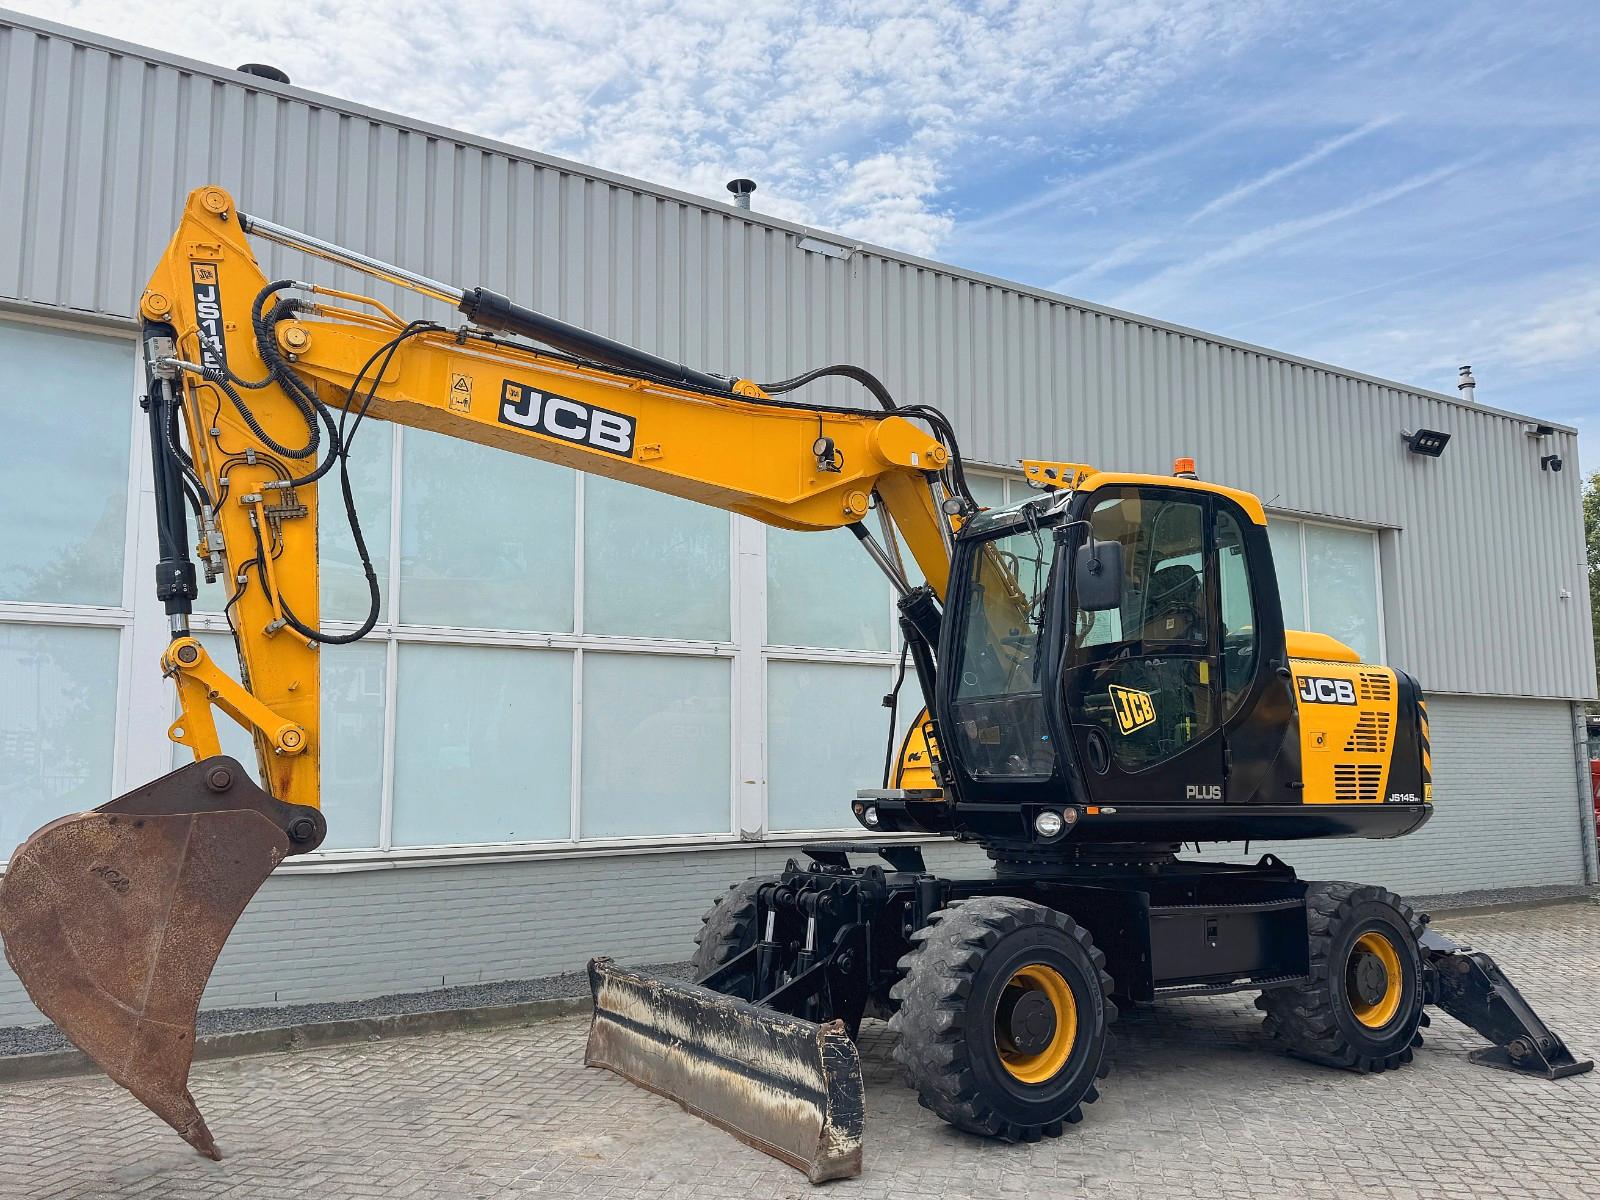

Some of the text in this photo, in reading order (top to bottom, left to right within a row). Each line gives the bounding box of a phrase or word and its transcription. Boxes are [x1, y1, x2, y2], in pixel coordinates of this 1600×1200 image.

[503, 392, 632, 452] JCB
[1300, 679, 1355, 703] JCB
[1117, 690, 1153, 729] JCB
[1186, 785, 1221, 799] PLUS
